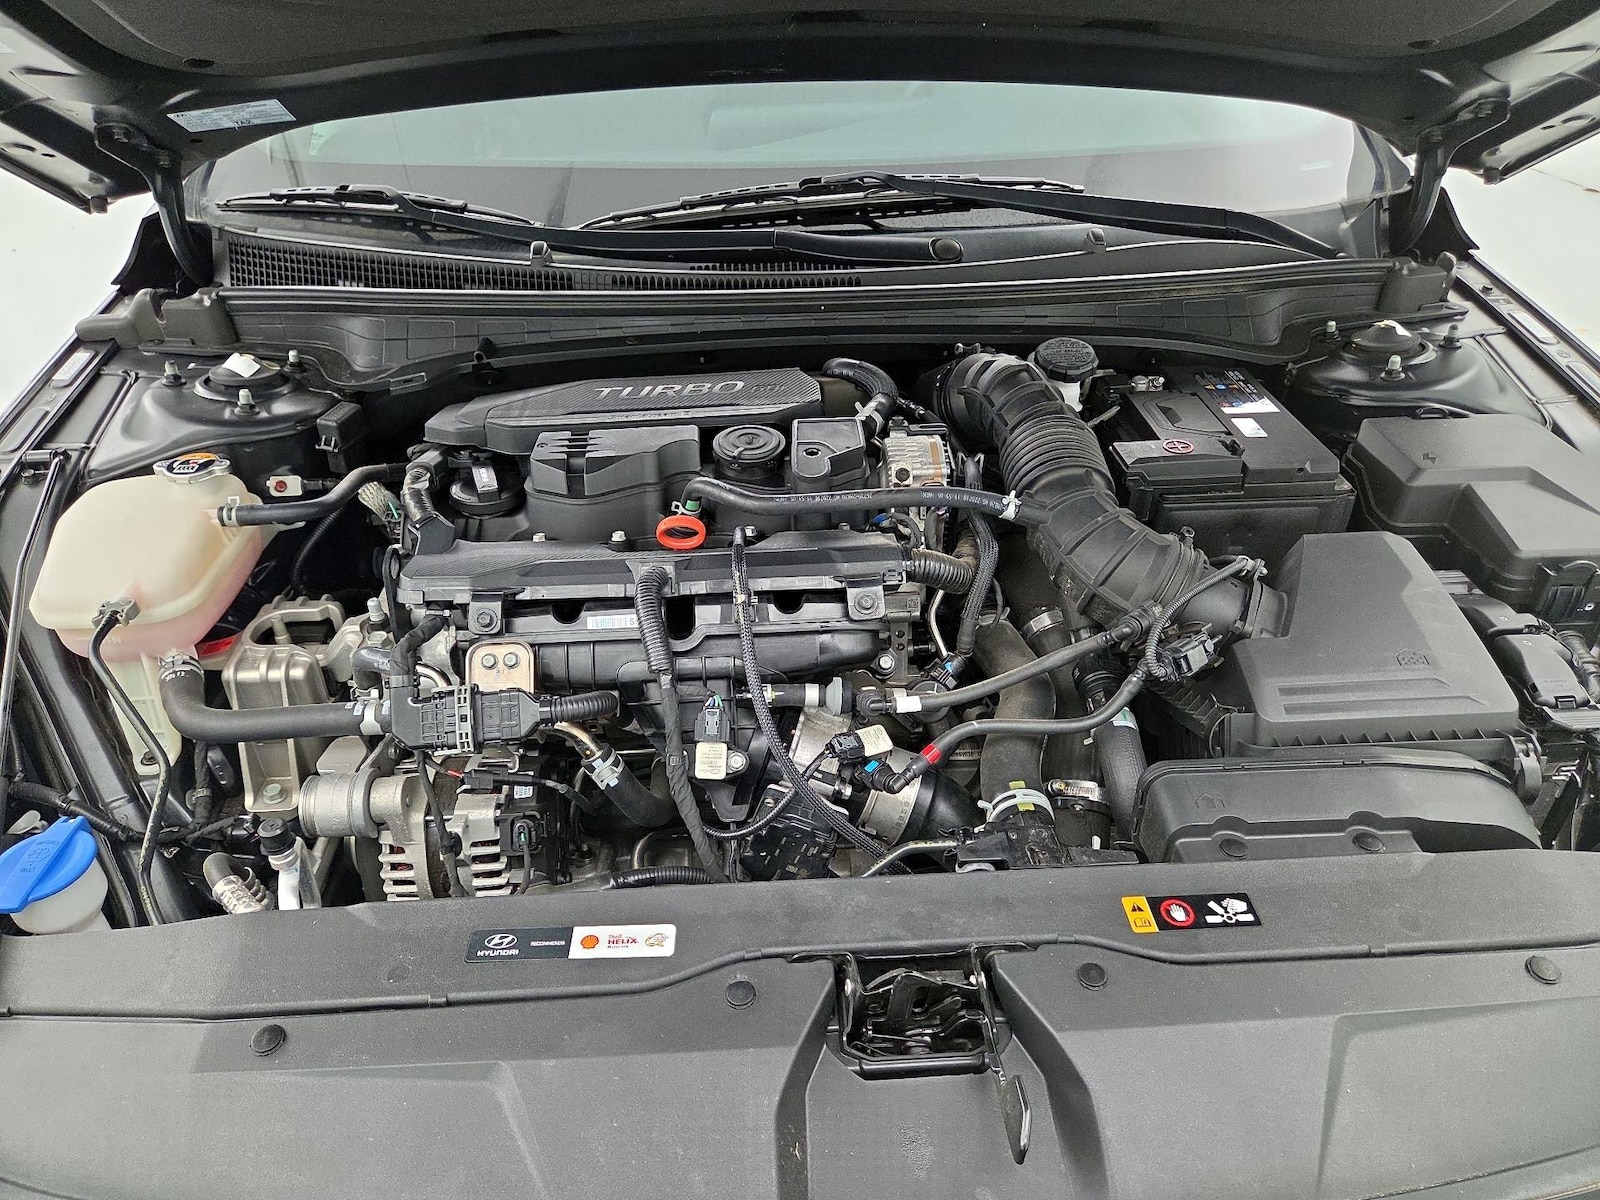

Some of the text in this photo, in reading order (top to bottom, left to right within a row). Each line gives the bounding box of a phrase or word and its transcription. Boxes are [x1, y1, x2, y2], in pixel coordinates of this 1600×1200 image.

[594, 380, 745, 400] TURBO
[607, 937, 638, 945] HELIX
[476, 948, 520, 957] HYUNDAI
